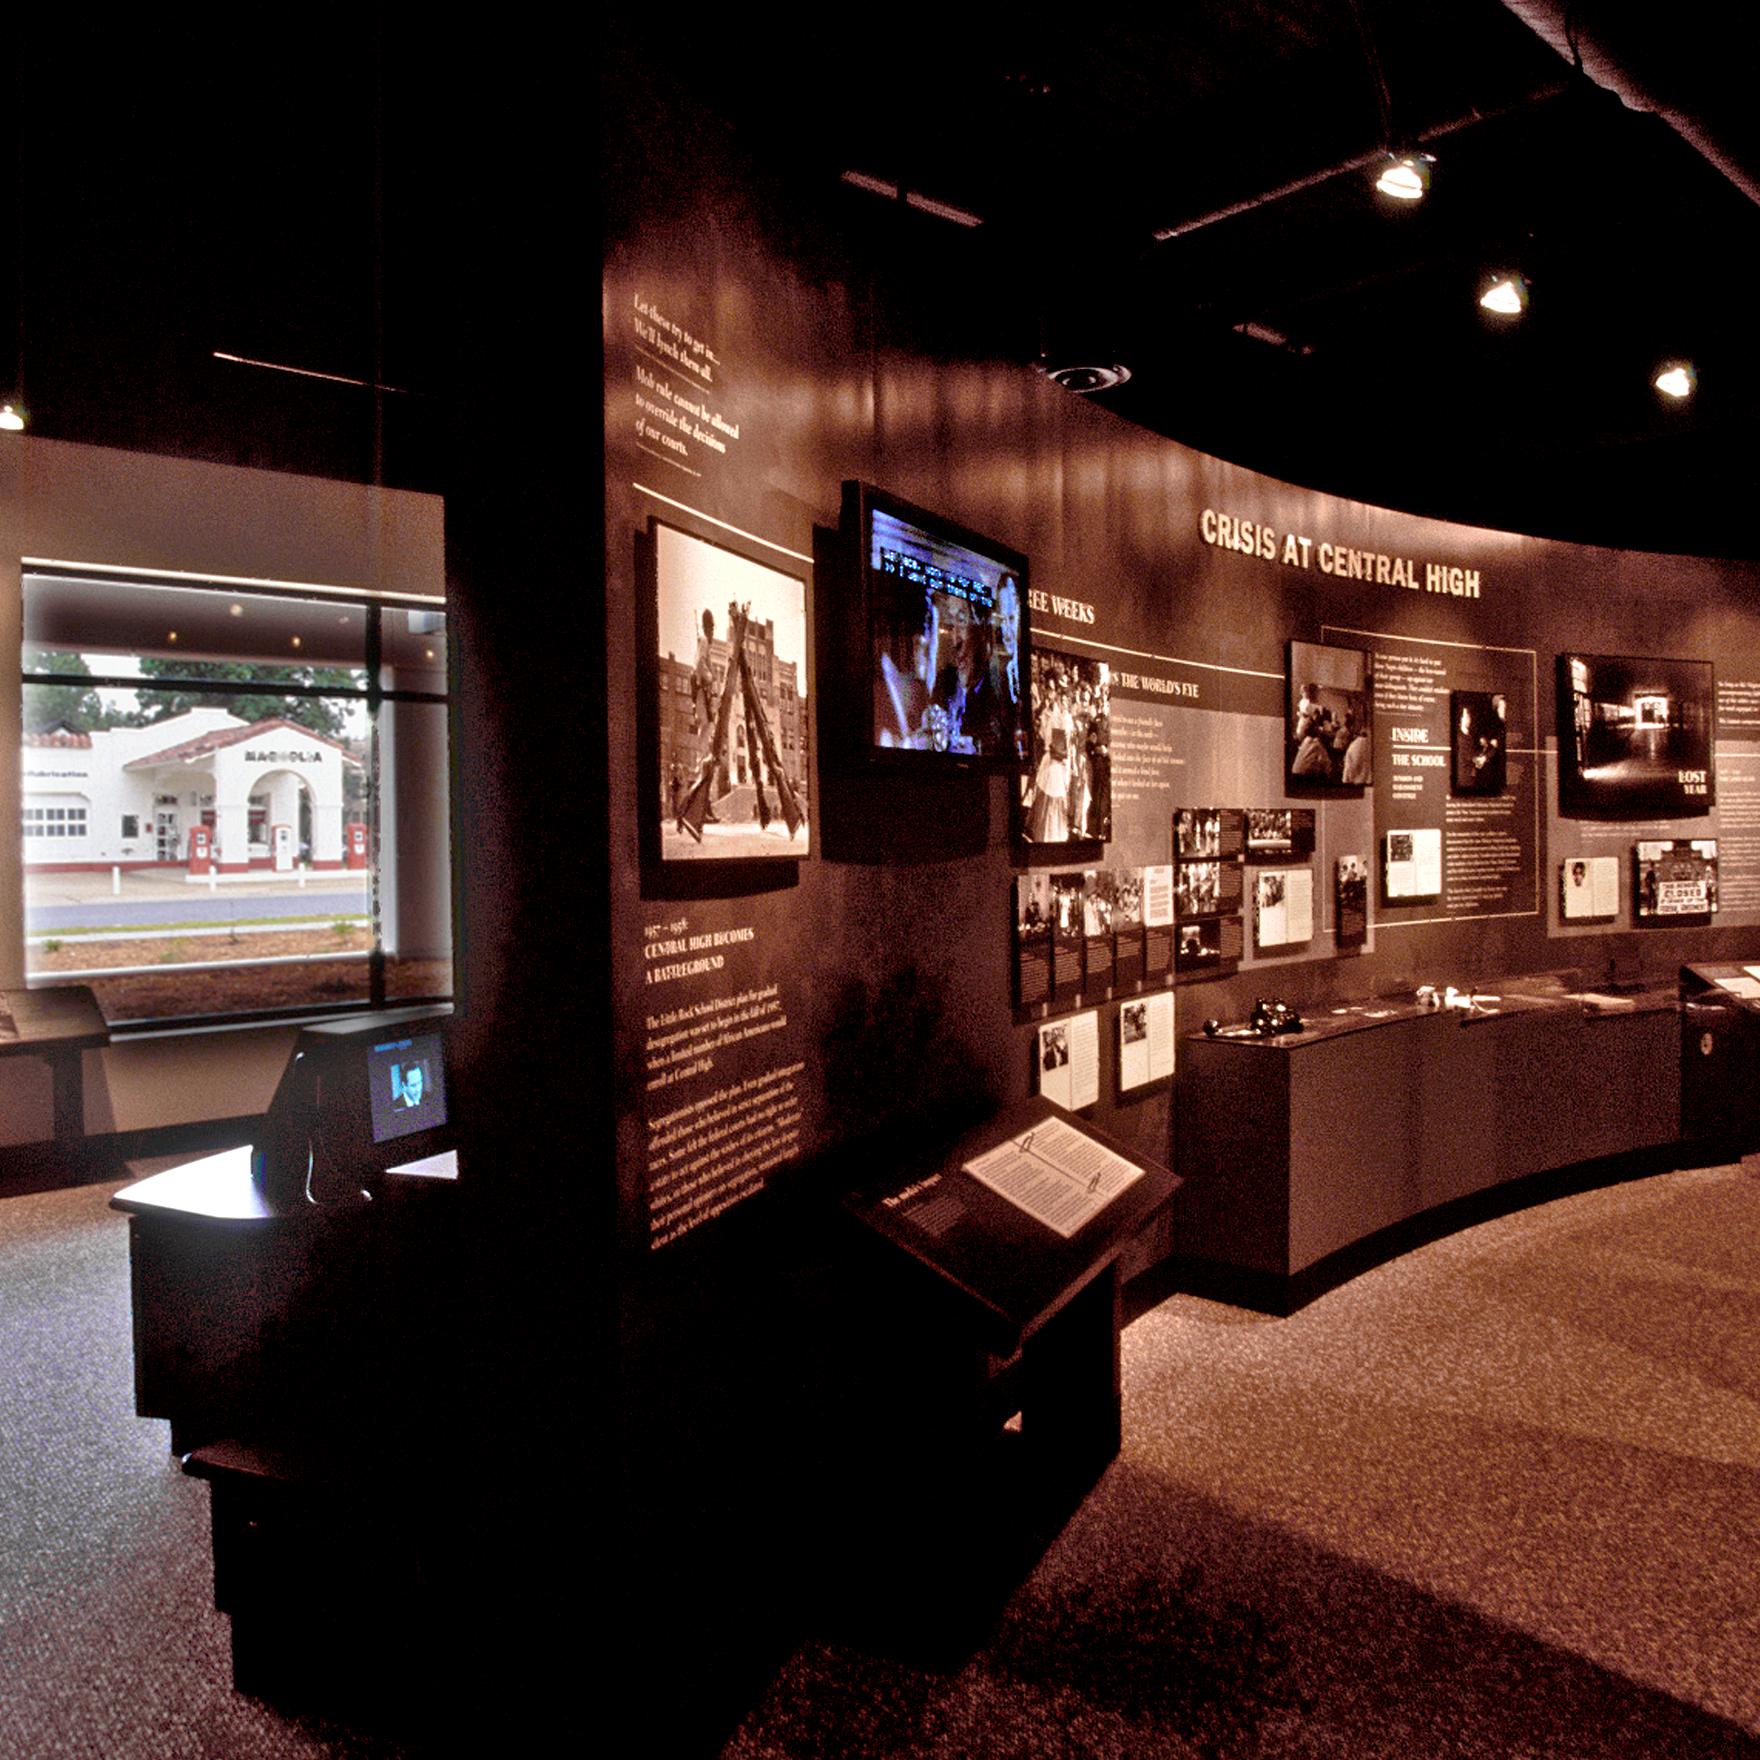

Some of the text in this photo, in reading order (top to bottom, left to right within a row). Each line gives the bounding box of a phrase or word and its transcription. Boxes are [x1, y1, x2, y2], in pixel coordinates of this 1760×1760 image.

[634, 294, 648, 315] Let
[649, 305, 670, 331] them
[671, 323, 682, 343] try
[684, 332, 693, 345] to
[693, 340, 704, 355] get
[657, 332, 679, 360] lynch
[680, 350, 699, 373] them
[636, 366, 739, 439] Mob rule cannot be allowed
[635, 394, 726, 454] to override the decisions
[635, 418, 645, 437] of
[646, 426, 660, 441] our
[1201, 509, 1480, 598] CRISIS AT CENTRAL HIGH
[1052, 595, 1095, 624] WEEKS
[1121, 672, 1139, 688] THE
[1141, 678, 1181, 696] WORLD'S
[1182, 684, 1199, 698] EYE
[1392, 728, 1429, 743] INSIDE
[245, 751, 322, 762] MAGOLA
[1392, 754, 1447, 767] THE SCHOOL
[1678, 770, 1707, 783] LOST
[1684, 784, 1707, 794] YEAR
[644, 927, 754, 959] CENTRAL HIGH BECOMES
[645, 955, 724, 984] A BATTLEGROUND
